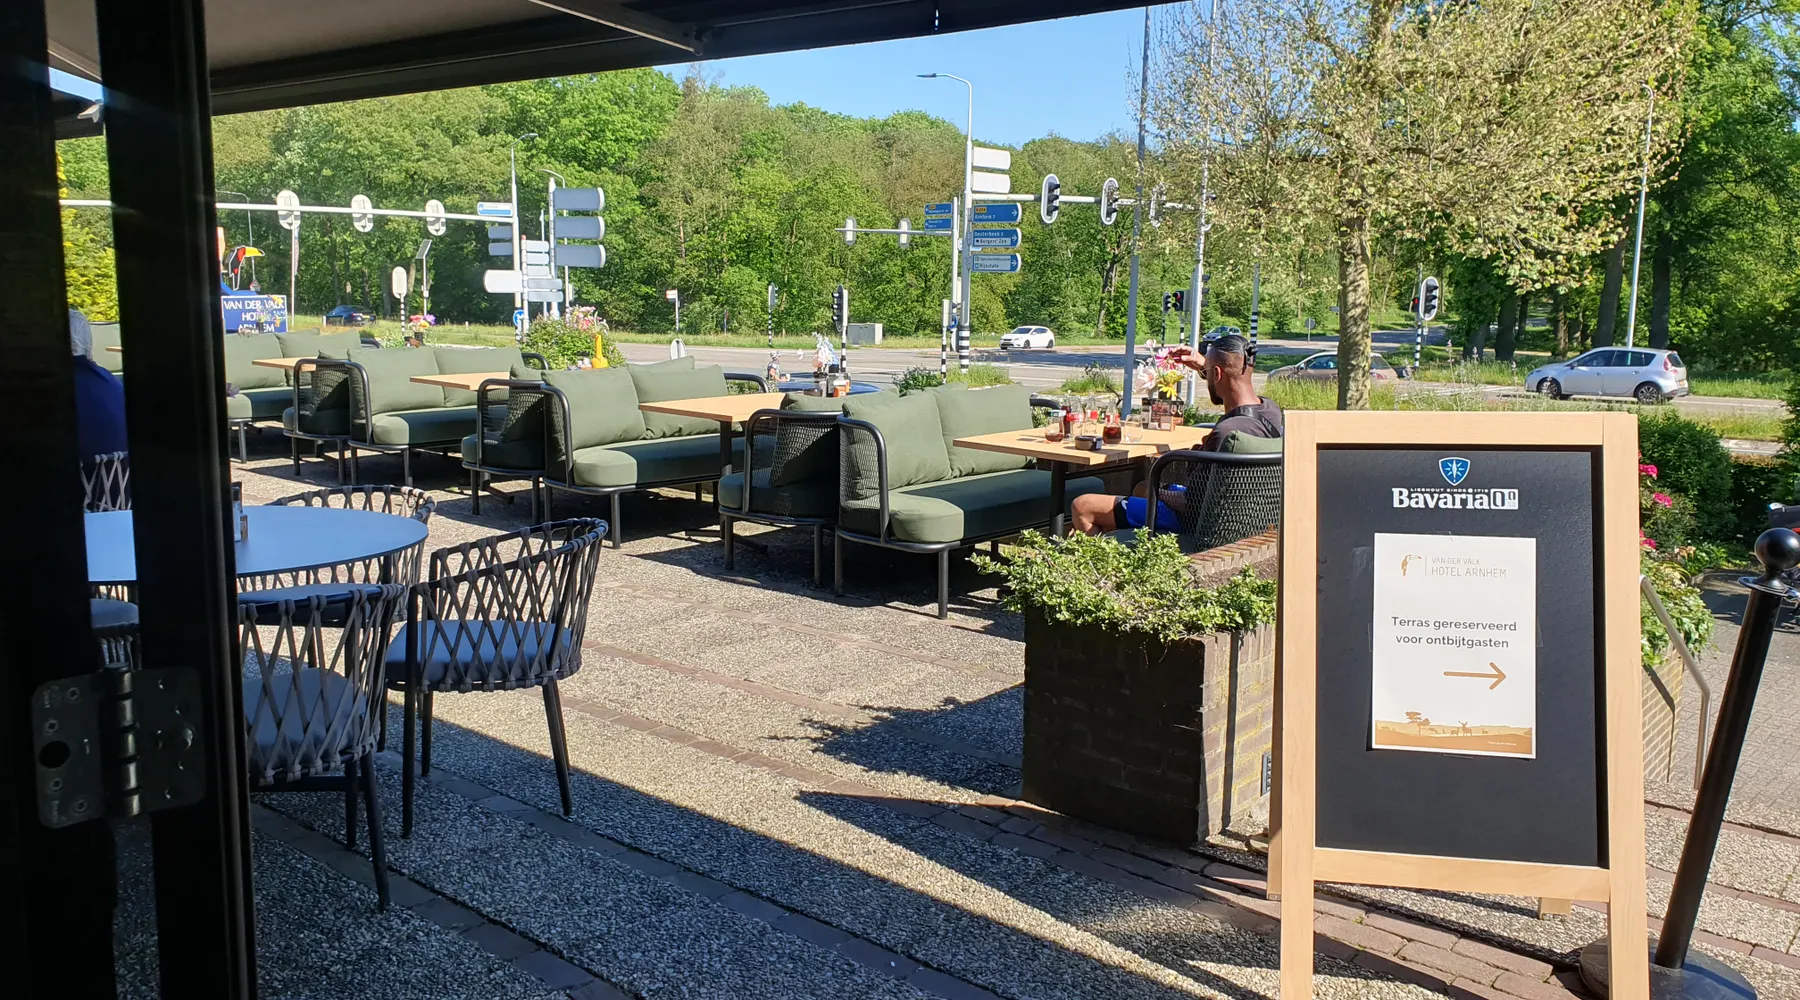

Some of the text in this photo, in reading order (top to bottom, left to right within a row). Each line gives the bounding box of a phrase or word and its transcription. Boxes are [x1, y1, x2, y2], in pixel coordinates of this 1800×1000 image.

[224, 300, 285, 310] VAN DER VALK
[1392, 487, 1490, 510] Bavaria
[1432, 566, 1507, 578] HOTEL ARNHEM
[1391, 616, 1517, 631] Terras gereserveerd
[1396, 635, 1509, 649] voor ontbijtgasten
